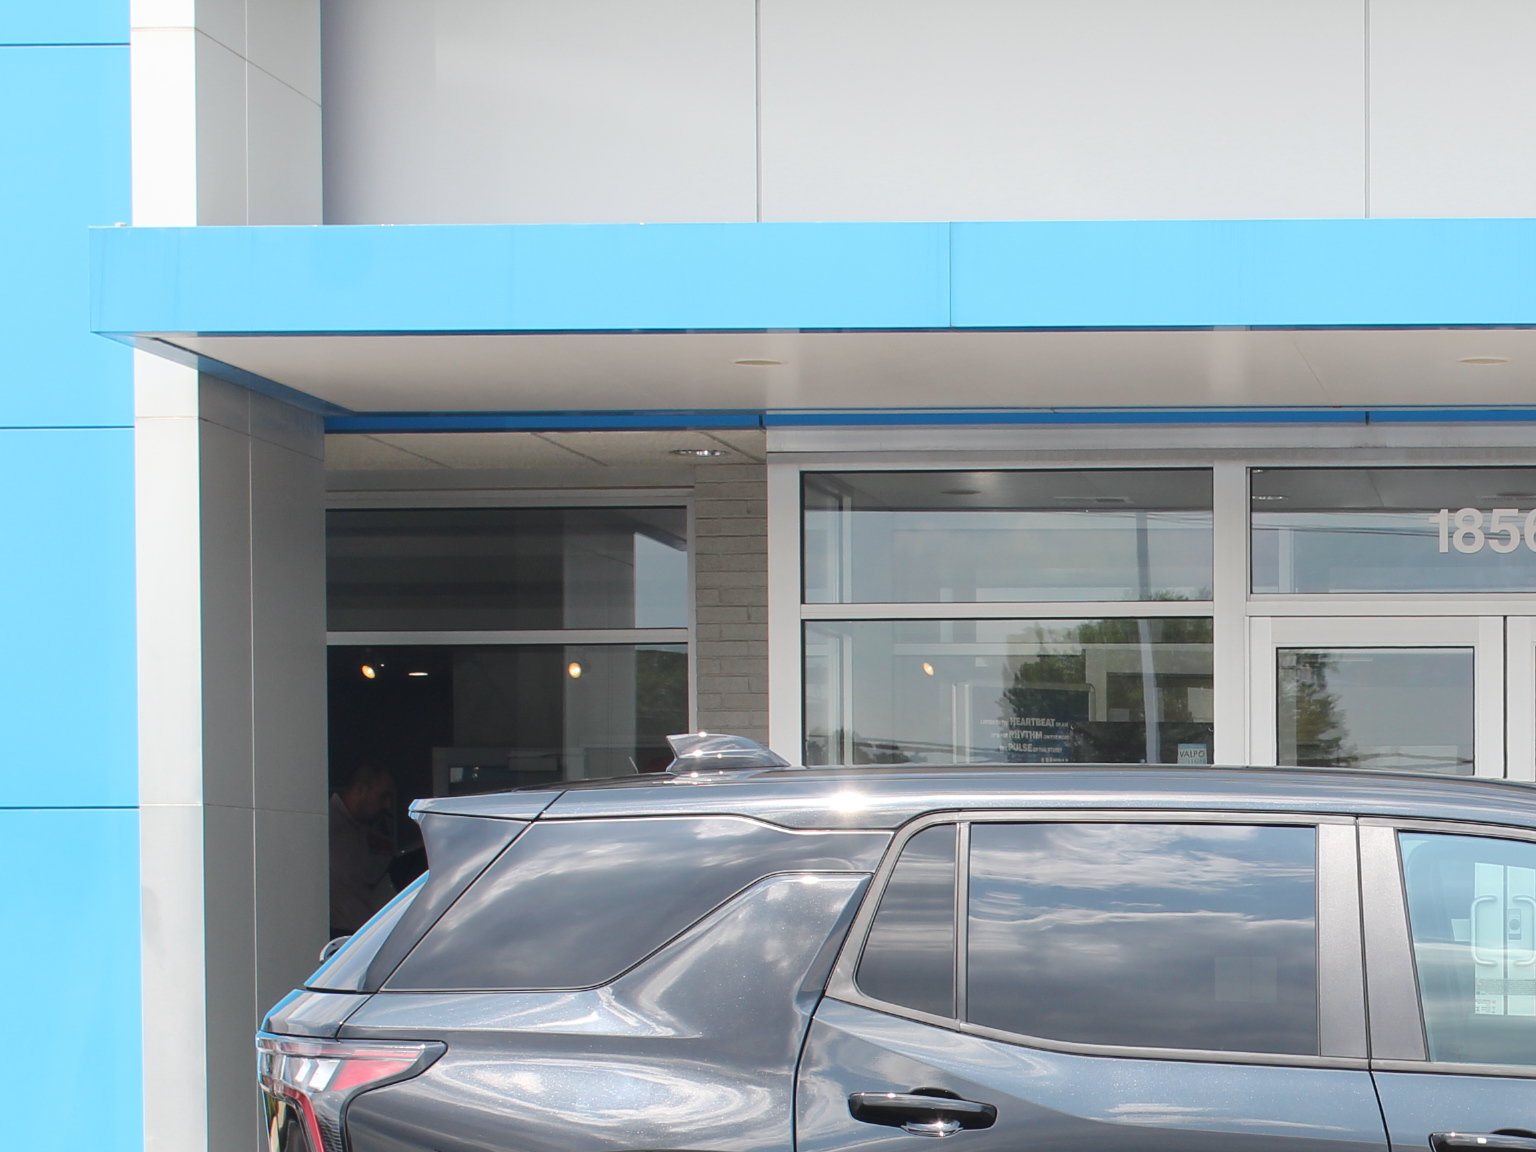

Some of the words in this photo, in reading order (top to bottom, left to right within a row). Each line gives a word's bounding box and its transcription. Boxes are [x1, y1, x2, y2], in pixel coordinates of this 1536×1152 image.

[1010, 716, 1055, 727] HEARTBEAT
[1008, 730, 1042, 740] RHYTHM
[1007, 743, 1032, 752] PULSE
